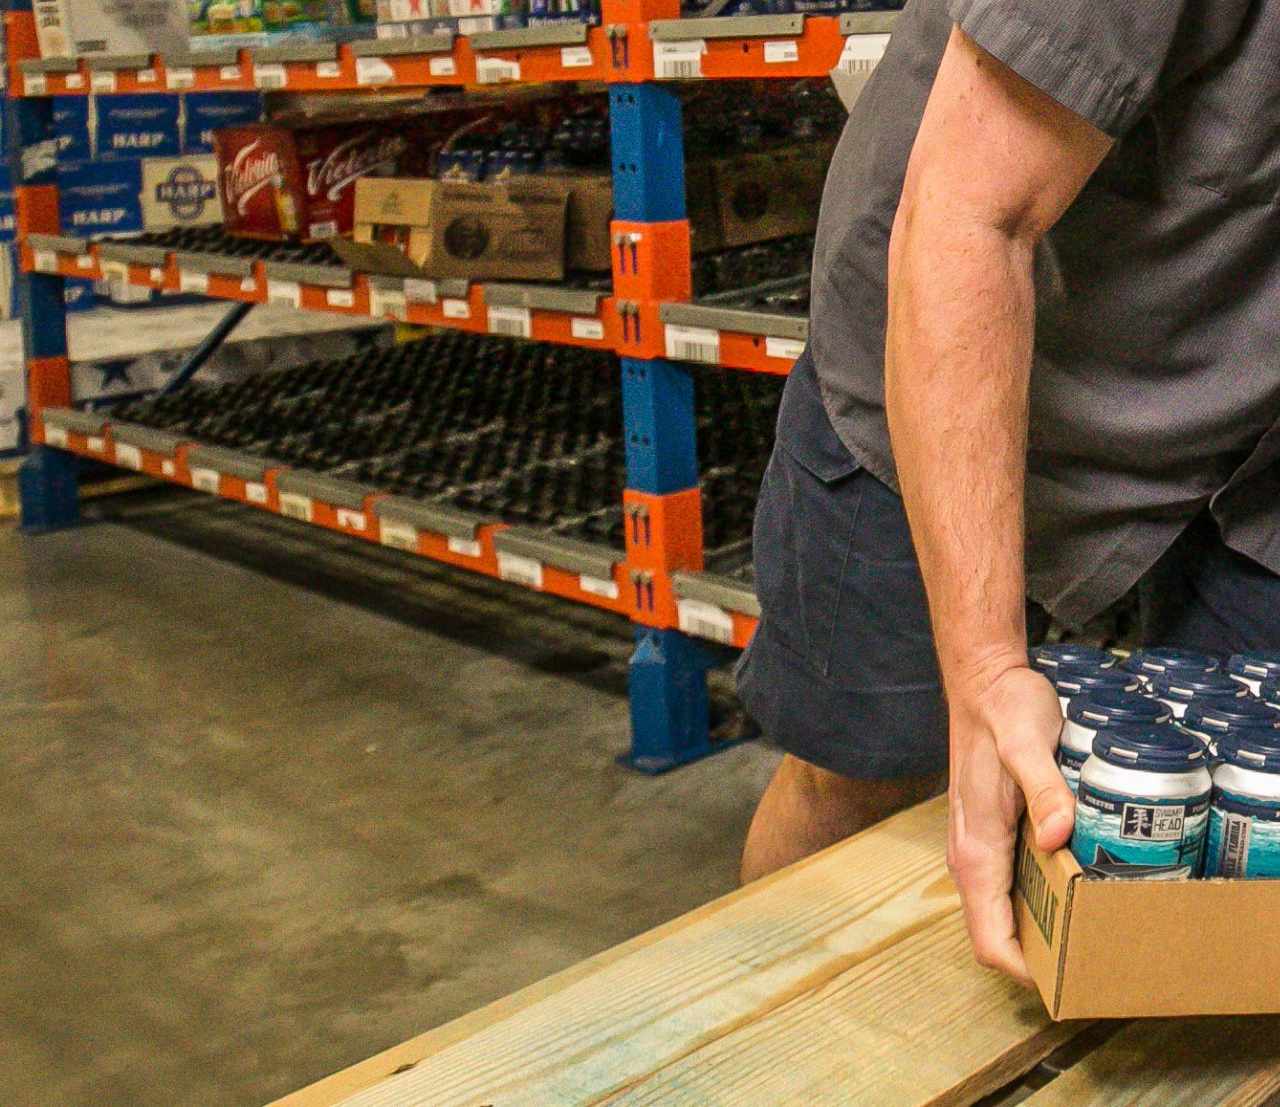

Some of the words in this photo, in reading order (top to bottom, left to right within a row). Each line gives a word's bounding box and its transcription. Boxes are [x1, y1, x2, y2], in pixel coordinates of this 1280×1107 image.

[112, 132, 165, 149] HARP
[72, 209, 127, 226] HARP
[1085, 794, 1115, 811] FOREVER
[1155, 808, 1183, 818] SWAMP
[1153, 817, 1181, 831] HEAD
